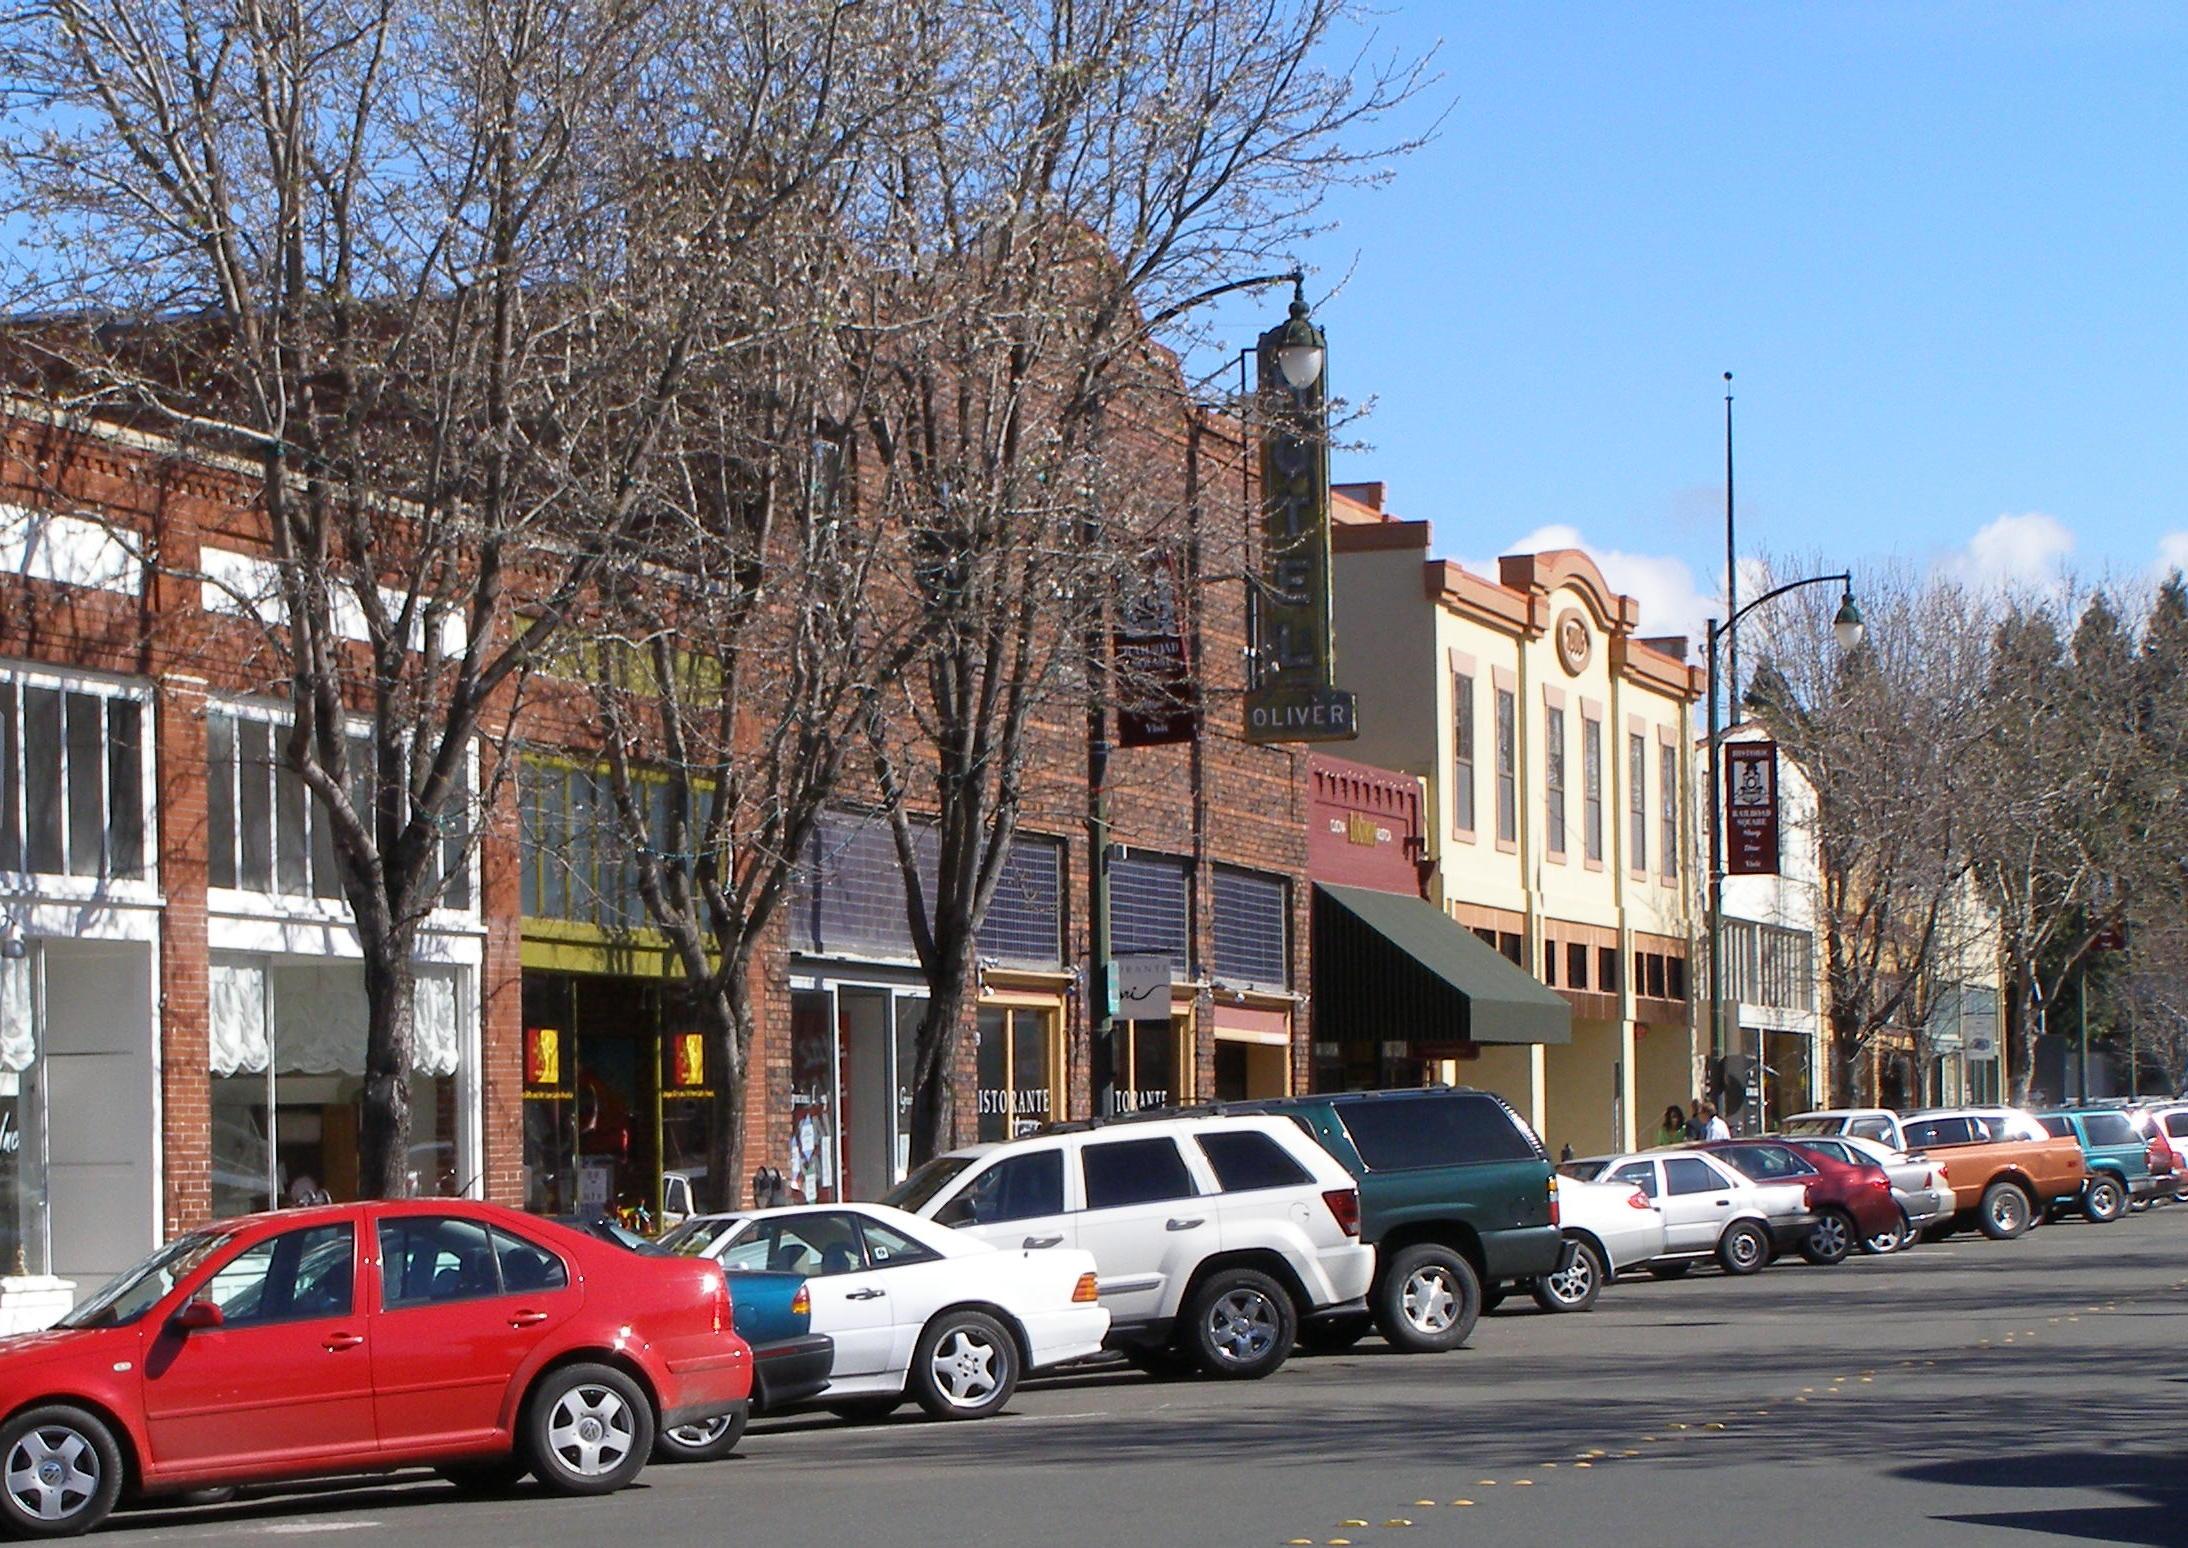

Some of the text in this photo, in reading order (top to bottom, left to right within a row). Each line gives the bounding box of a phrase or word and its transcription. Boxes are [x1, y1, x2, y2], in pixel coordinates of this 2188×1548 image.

[1270, 380, 1312, 668] OTEL
[1253, 704, 1344, 727] OLIVER
[1732, 809, 1771, 817] RAILROAD
[978, 1088, 1050, 1113] ISTORANTE
[1115, 1090, 1168, 1113] TORANTE
